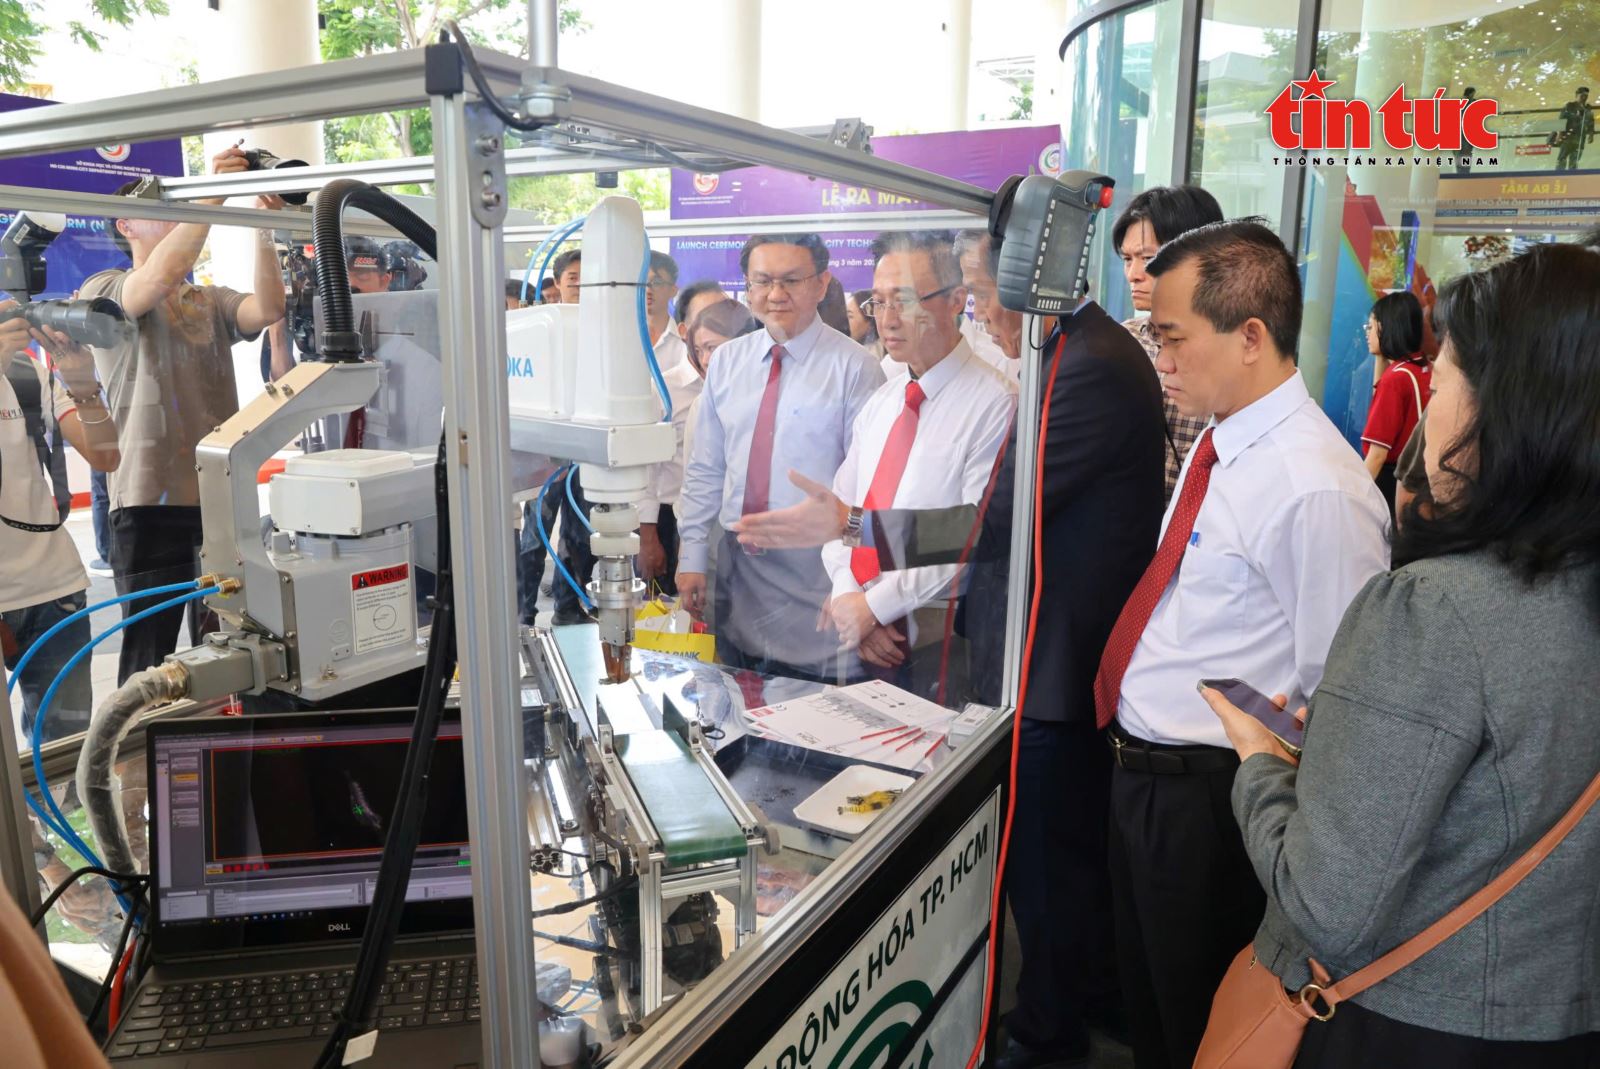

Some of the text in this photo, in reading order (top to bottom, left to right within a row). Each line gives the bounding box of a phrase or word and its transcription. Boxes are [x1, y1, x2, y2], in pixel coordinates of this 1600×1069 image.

[676, 240, 708, 249] LAUNCH
[824, 239, 845, 248] CITY
[867, 908, 915, 992] HÓA
[919, 874, 945, 926] TP.
[950, 823, 988, 893] HCM
[327, 922, 351, 932] DELL
